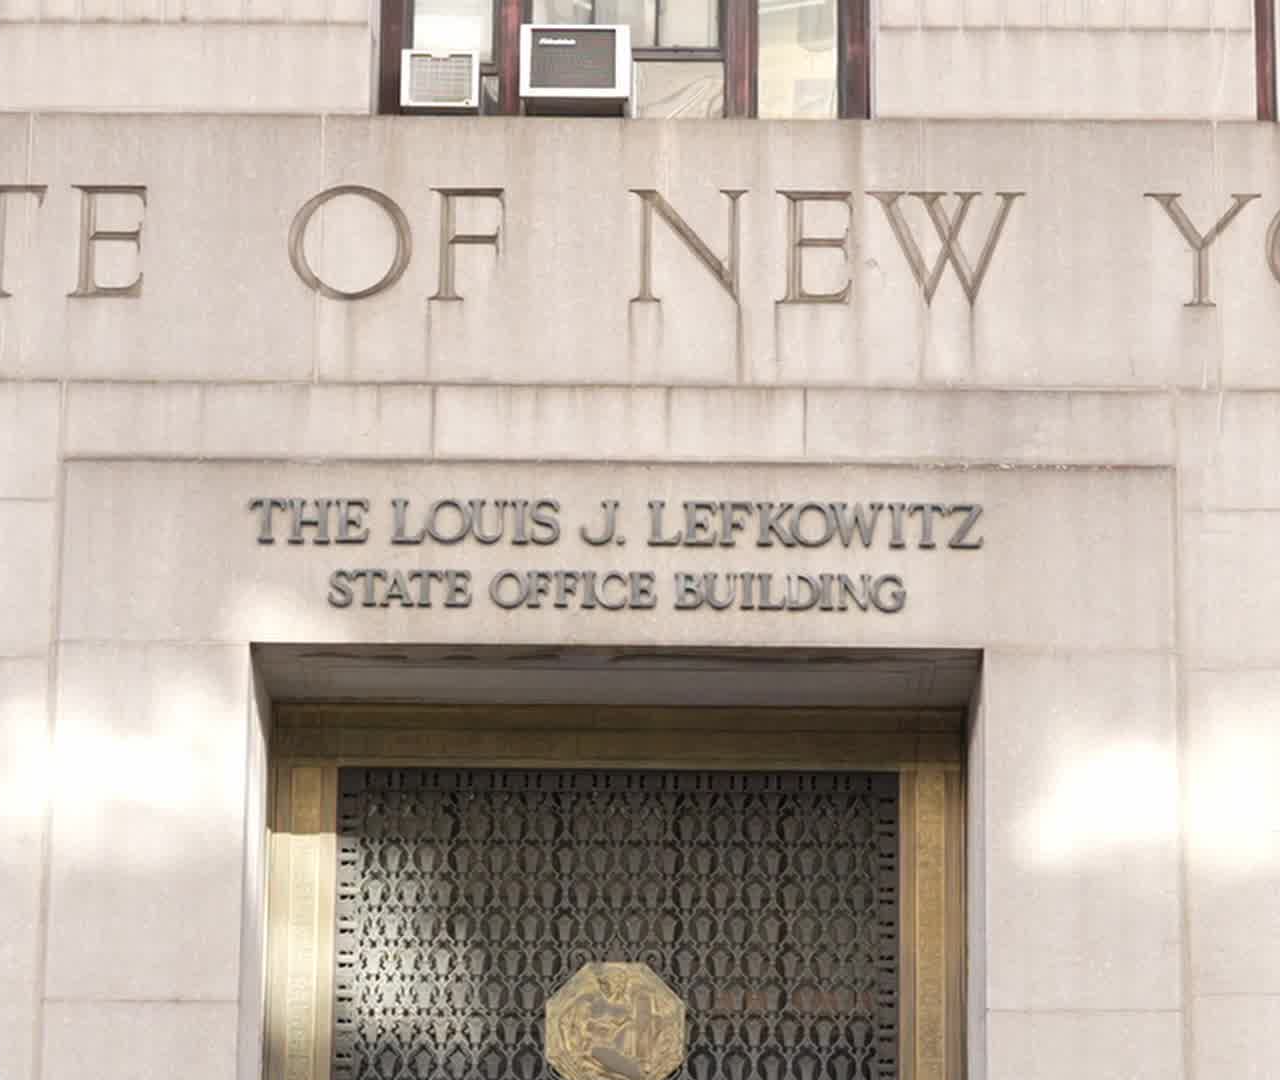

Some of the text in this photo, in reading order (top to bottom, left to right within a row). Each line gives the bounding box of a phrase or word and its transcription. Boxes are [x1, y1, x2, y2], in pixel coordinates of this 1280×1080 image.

[288, 185, 505, 301] OF
[628, 189, 1026, 305] NEW
[248, 497, 985, 550] THE LOUIS J. LEFKOWITZ
[327, 569, 907, 613] STATE OFFICE BUILDING
